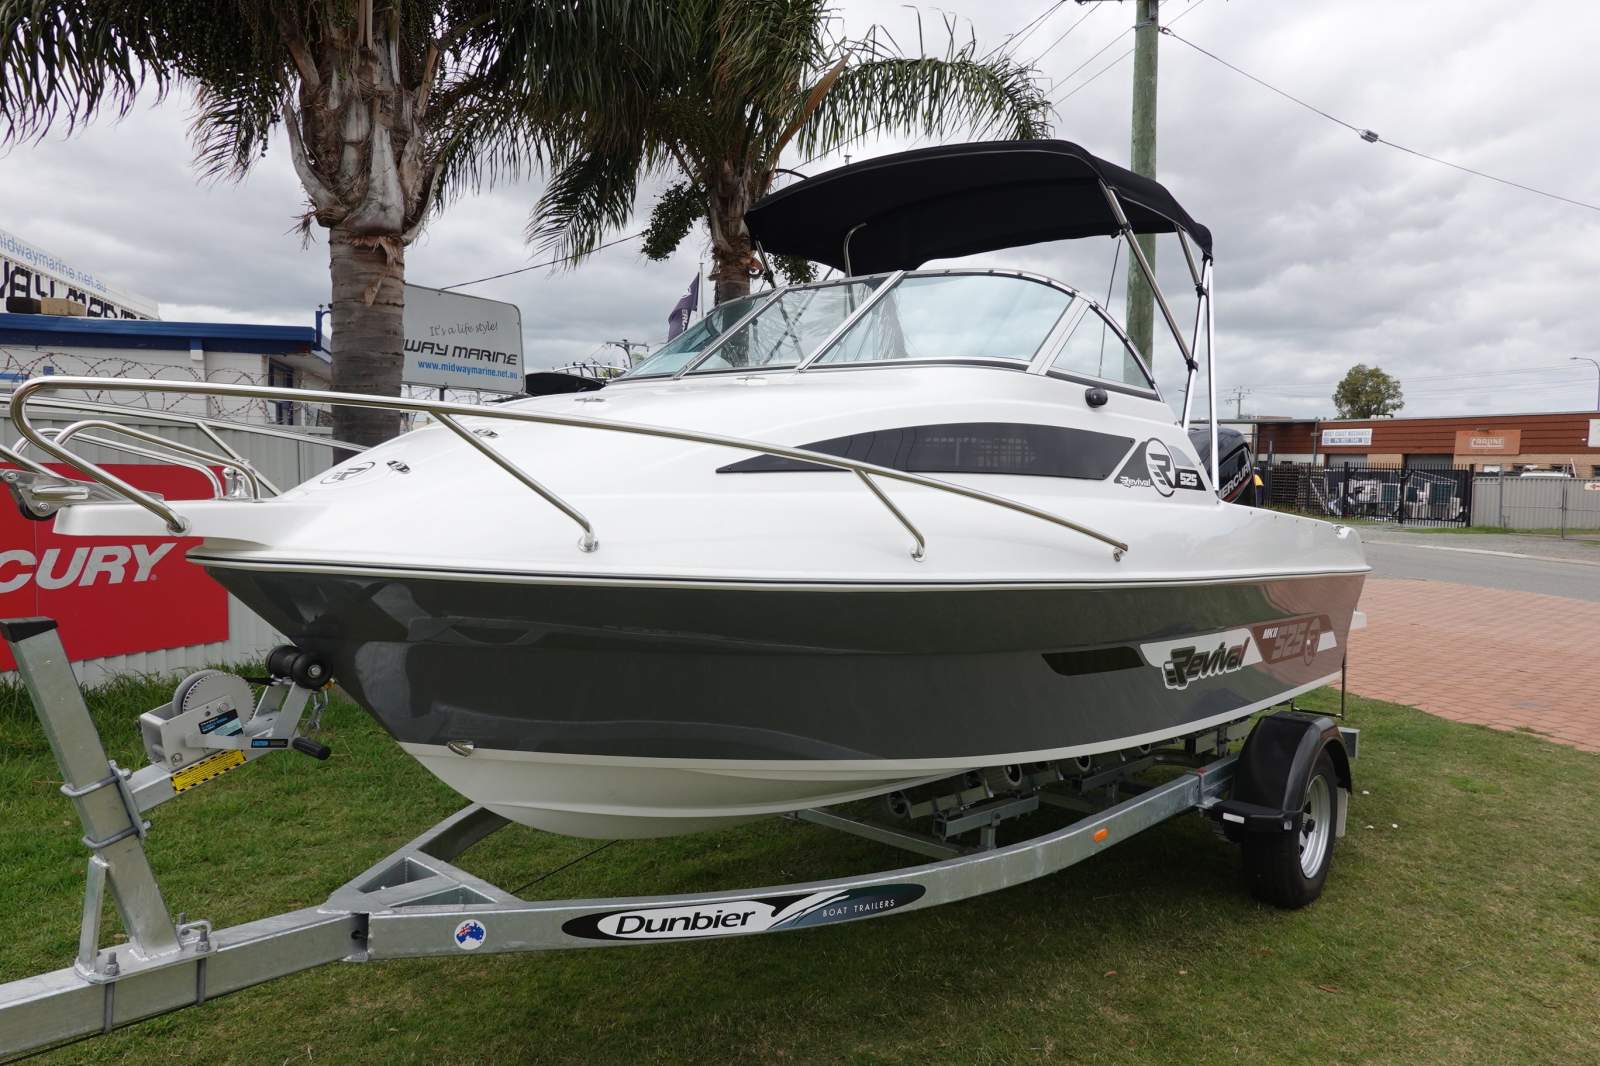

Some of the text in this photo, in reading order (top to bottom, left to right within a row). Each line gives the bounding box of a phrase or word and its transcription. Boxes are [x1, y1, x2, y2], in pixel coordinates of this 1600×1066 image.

[452, 345, 518, 365] MARINE
[417, 360, 518, 380] www.midwaymarine.net.au
[1162, 636, 1251, 688] Revival
[822, 899, 896, 917] BOAT TRAILERS
[615, 909, 756, 934] Dunbier
